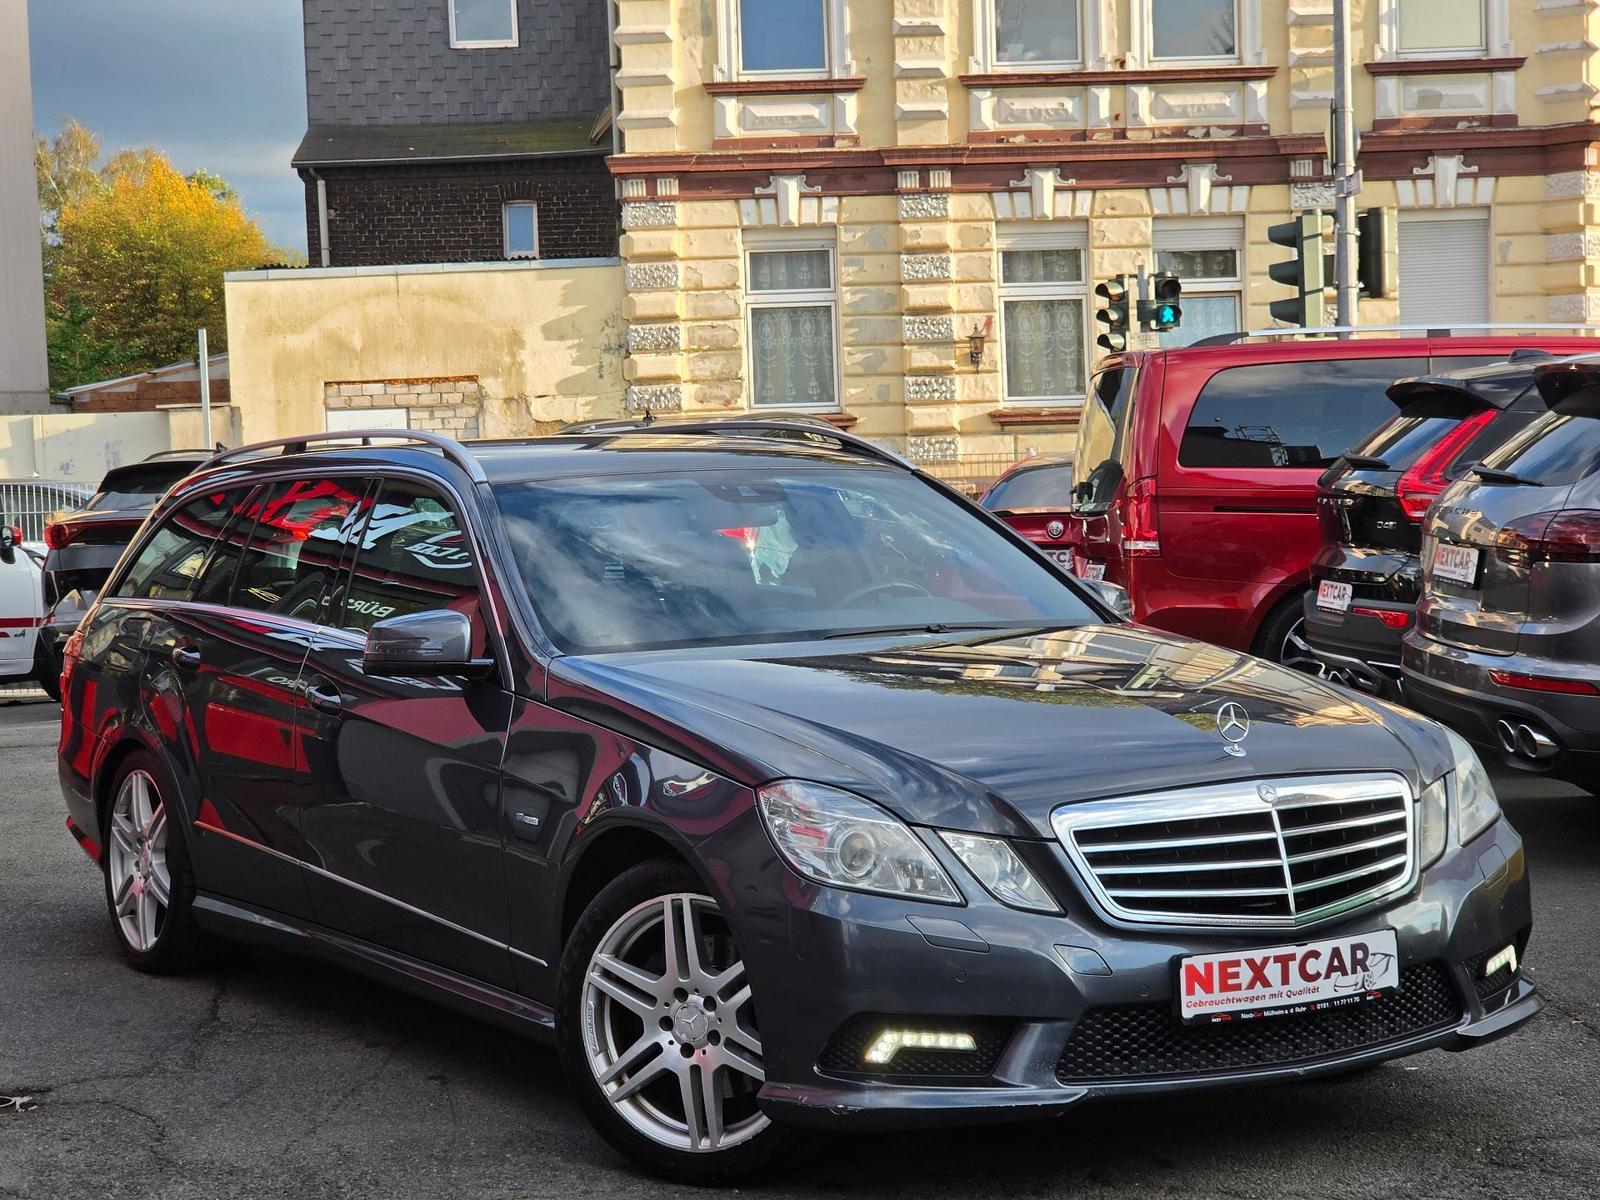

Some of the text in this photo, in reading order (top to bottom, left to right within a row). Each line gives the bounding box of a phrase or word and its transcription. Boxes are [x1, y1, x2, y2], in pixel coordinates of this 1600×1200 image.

[1184, 942, 1372, 997] NEXTCAR
[1186, 986, 1320, 1009] Gebrauchtwagen mit Qualität
